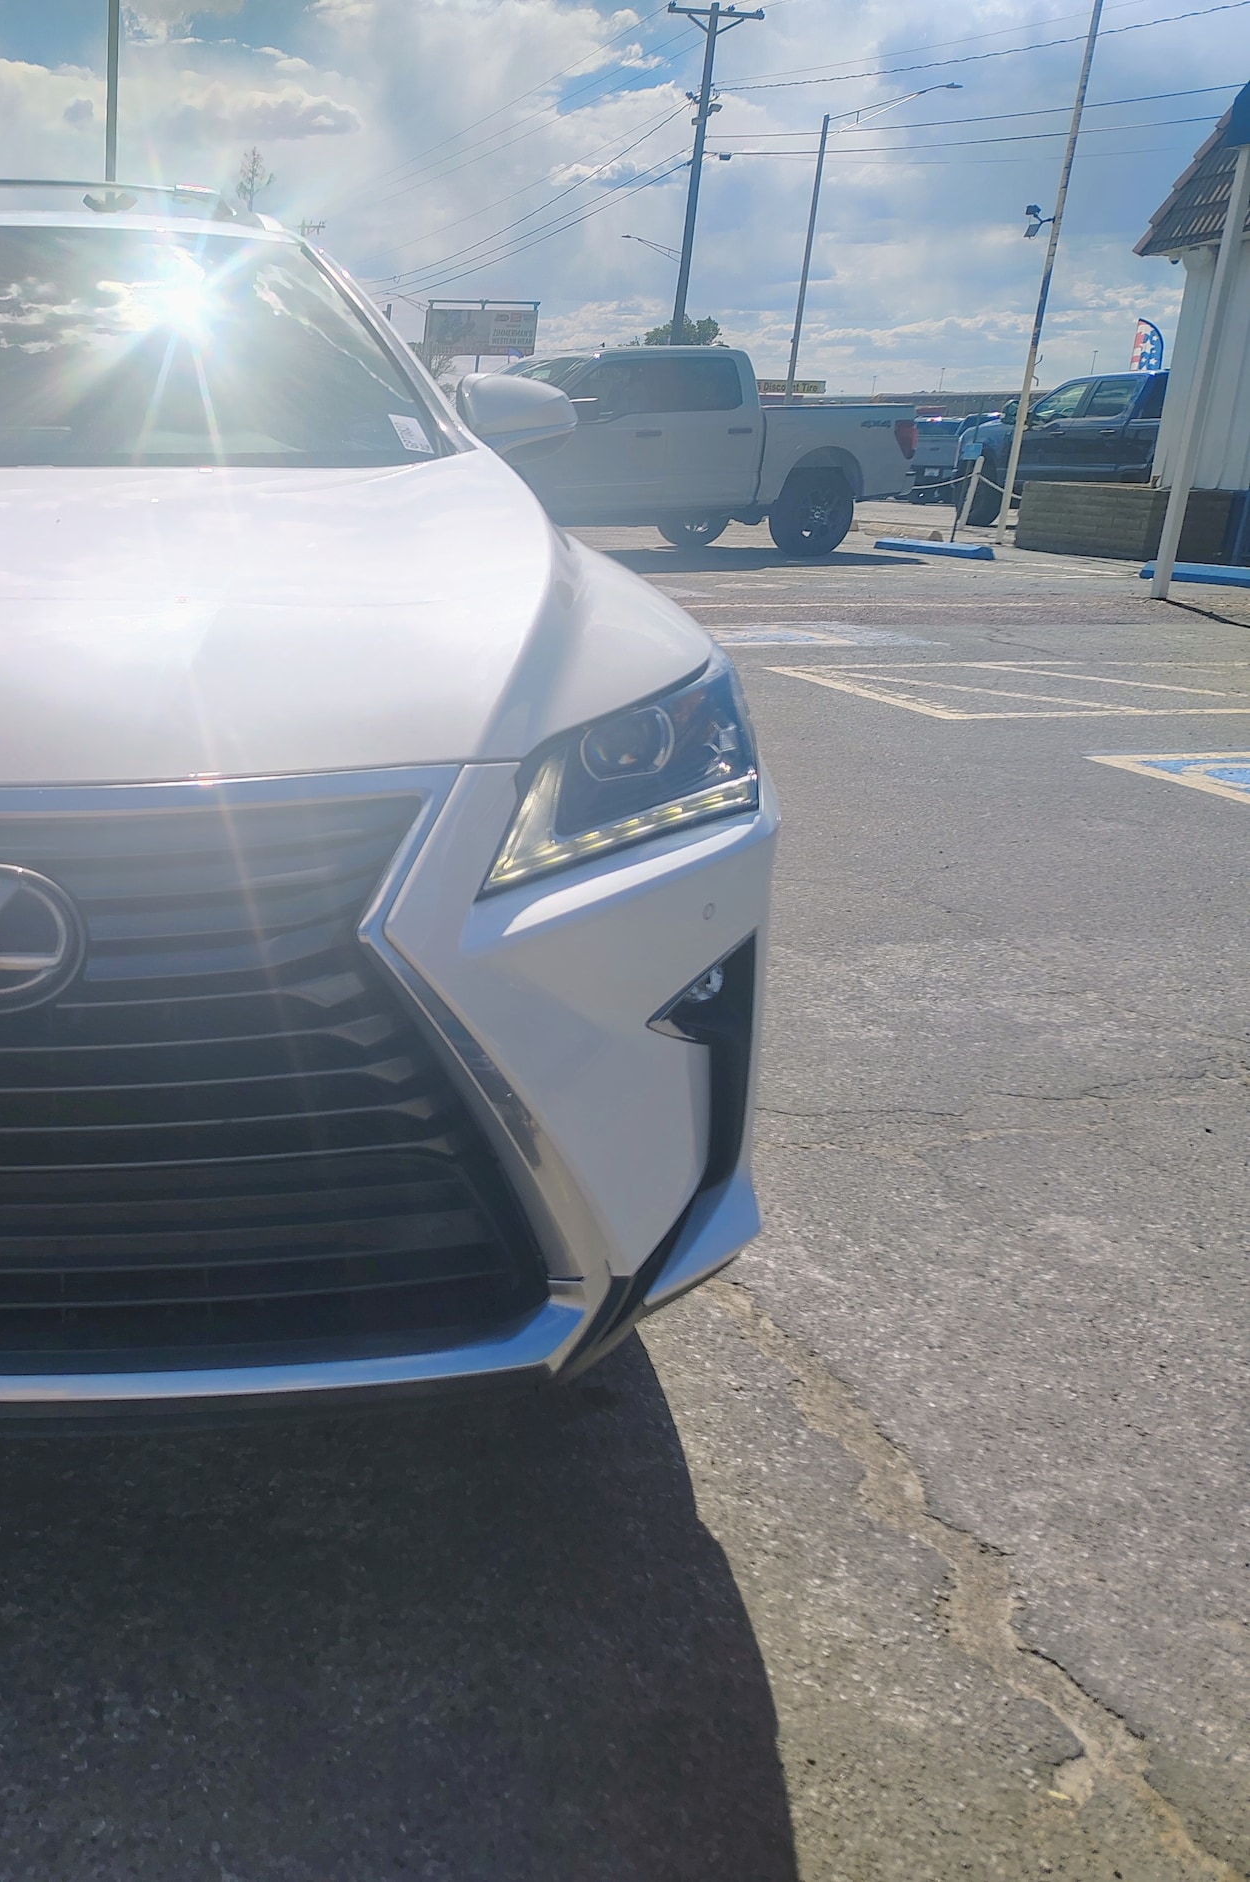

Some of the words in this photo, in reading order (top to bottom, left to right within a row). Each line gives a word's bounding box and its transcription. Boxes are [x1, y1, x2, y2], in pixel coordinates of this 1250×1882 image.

[493, 329, 533, 337] ZIMMERMAN'S
[763, 383, 799, 392] Discot
[802, 383, 818, 392] Tire
